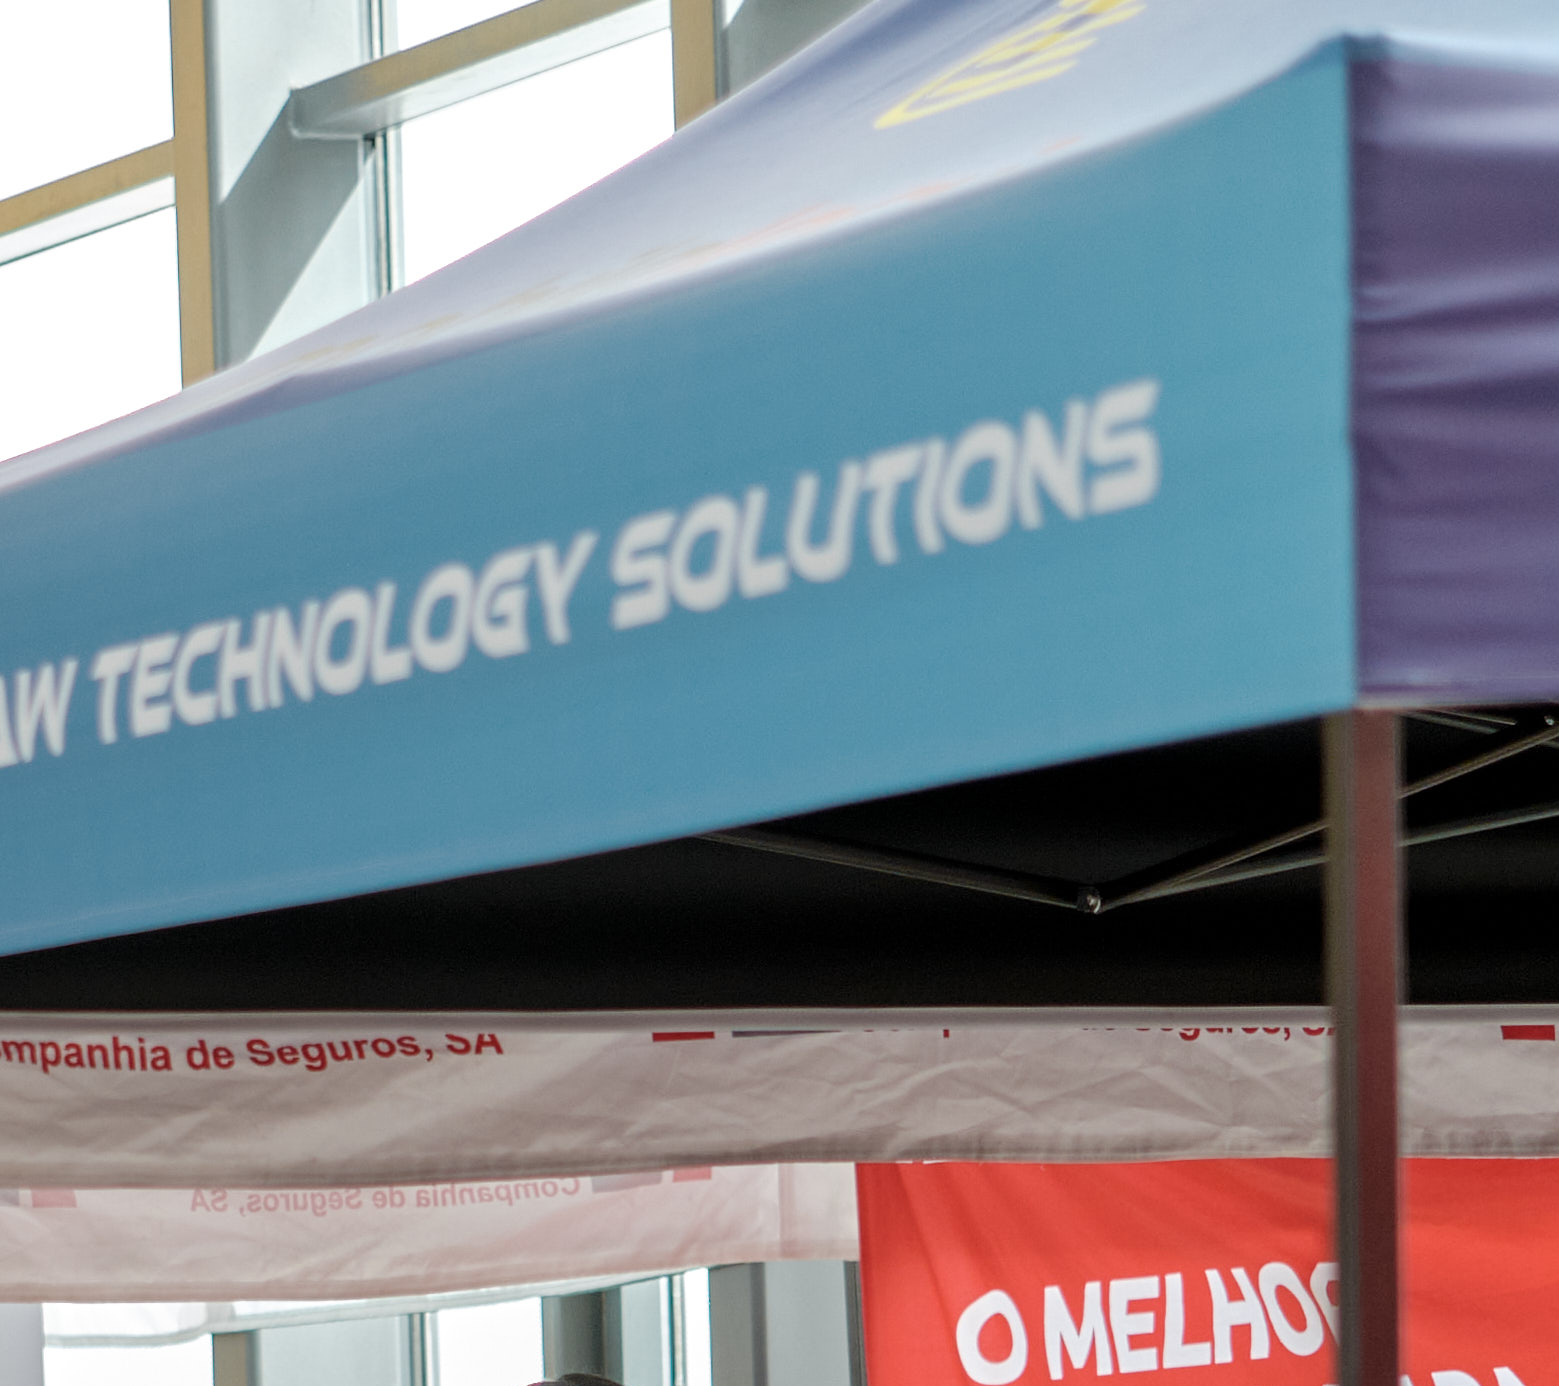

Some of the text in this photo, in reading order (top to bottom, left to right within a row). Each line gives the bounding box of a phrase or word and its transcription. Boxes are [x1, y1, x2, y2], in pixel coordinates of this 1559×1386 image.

[89, 529, 600, 746] TECHNOLOGY
[609, 375, 1163, 633] SOLUTIONS
[186, 1039, 235, 1071] de
[249, 1034, 434, 1072] Seguros,
[957, 1289, 1028, 1386] O
